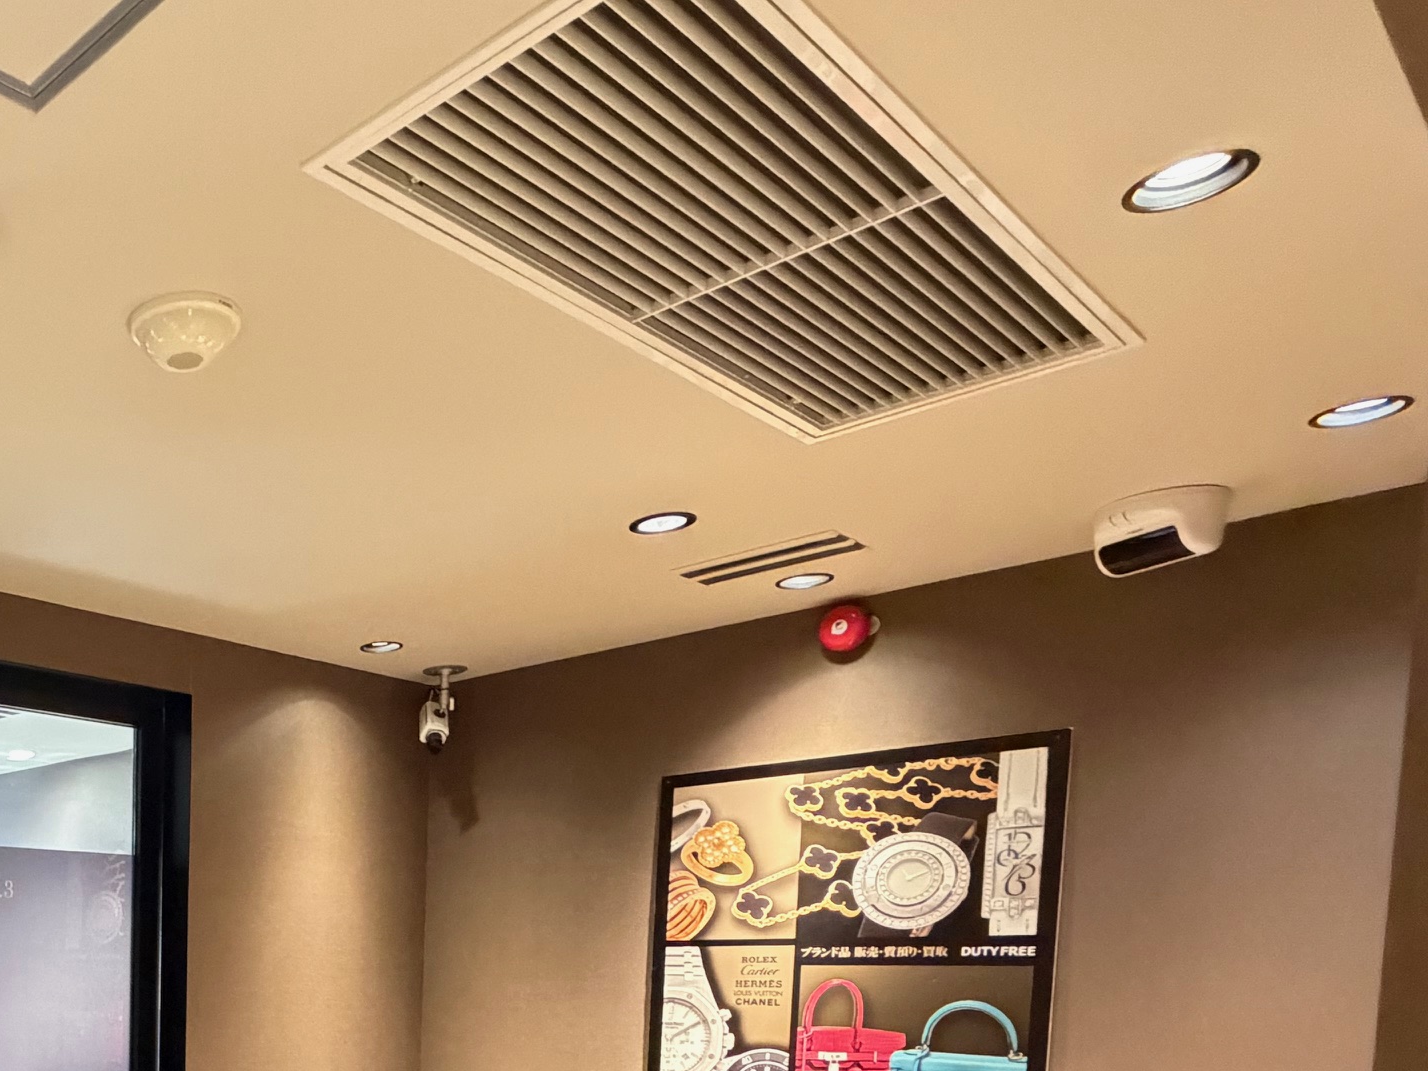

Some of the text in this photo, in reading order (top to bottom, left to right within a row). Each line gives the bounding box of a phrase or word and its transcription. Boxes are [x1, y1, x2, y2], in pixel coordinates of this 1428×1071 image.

[961, 945, 999, 957] DUTY
[1000, 945, 1037, 957] FREE
[741, 956, 778, 964] ROLEX
[740, 964, 780, 976] Cartier
[735, 997, 780, 1006] CHANEL
